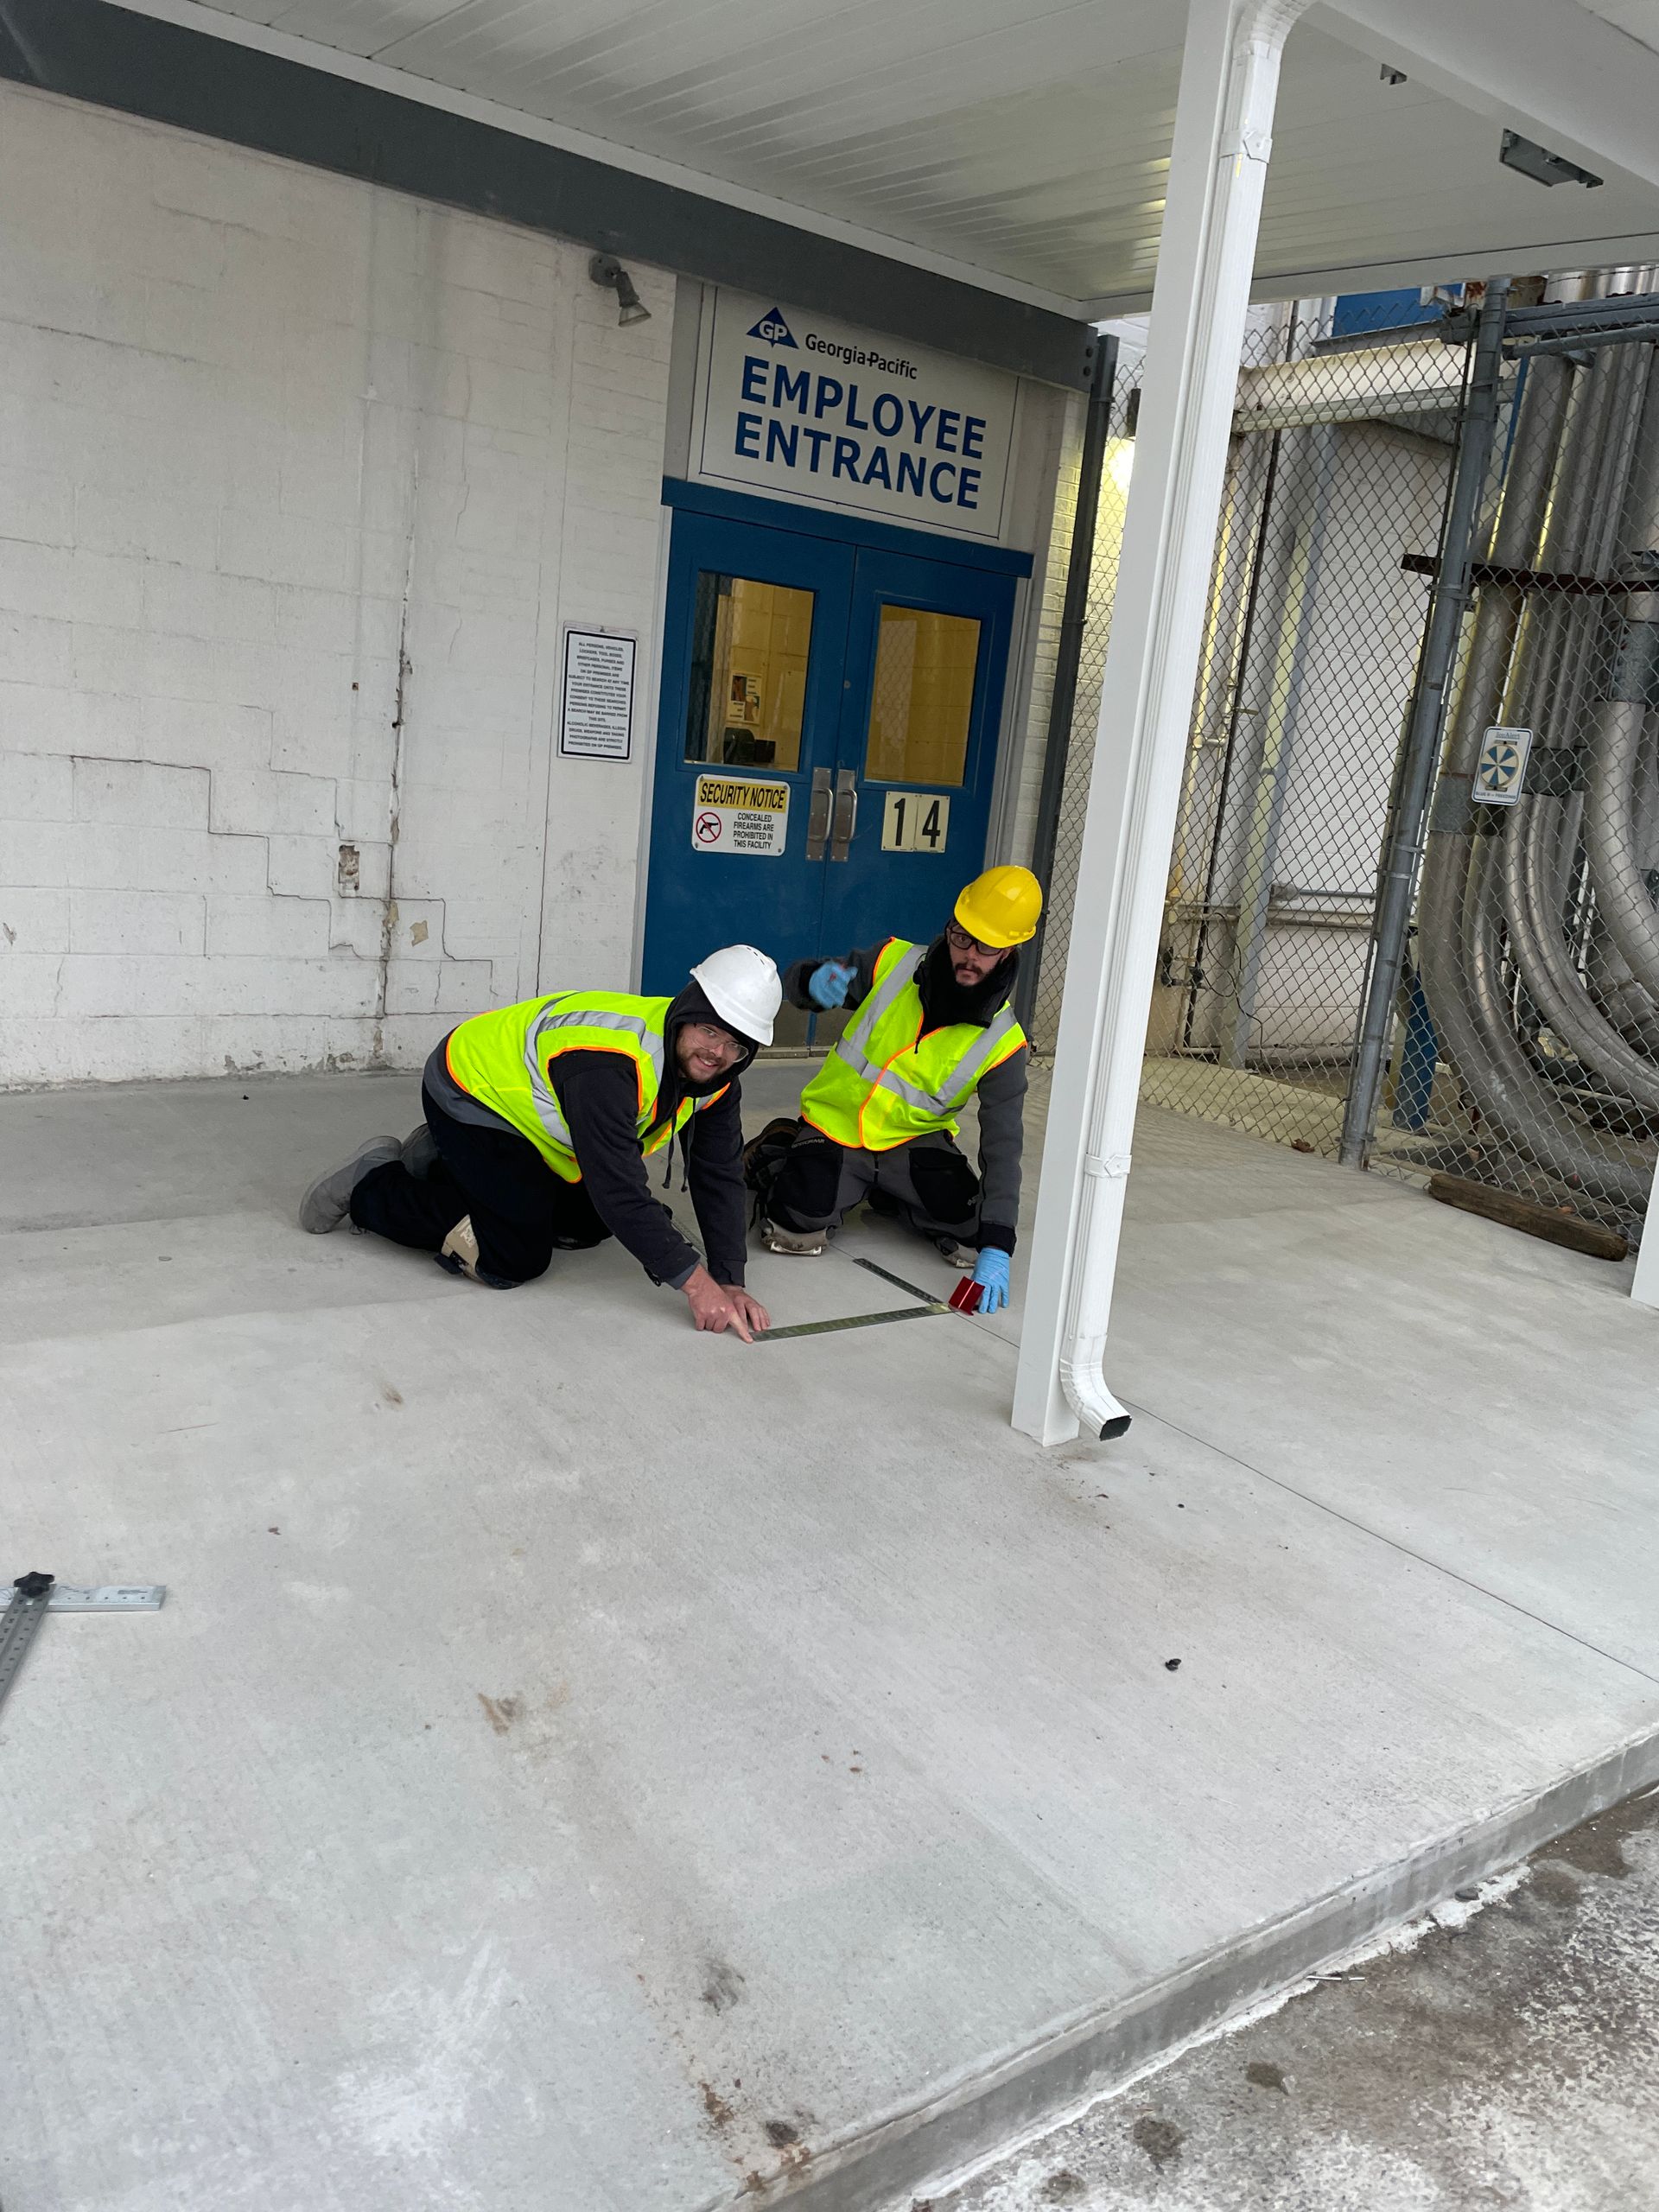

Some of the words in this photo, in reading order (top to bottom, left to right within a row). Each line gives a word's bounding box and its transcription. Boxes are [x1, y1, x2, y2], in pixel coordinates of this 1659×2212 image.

[759, 320, 788, 342] GP
[804, 333, 918, 380] Georgia-Pacific
[741, 355, 987, 459] EMPLOYEE
[734, 411, 982, 510] ENTRANCE
[701, 783, 750, 805] SECURITY
[750, 787, 785, 809] NOTICE
[734, 822, 762, 830] FIREARMS
[738, 812, 772, 822] CONCEALED
[733, 830, 766, 840] PROHIBITED
[734, 839, 747, 848] THIS
[747, 841, 772, 849] FACILITY
